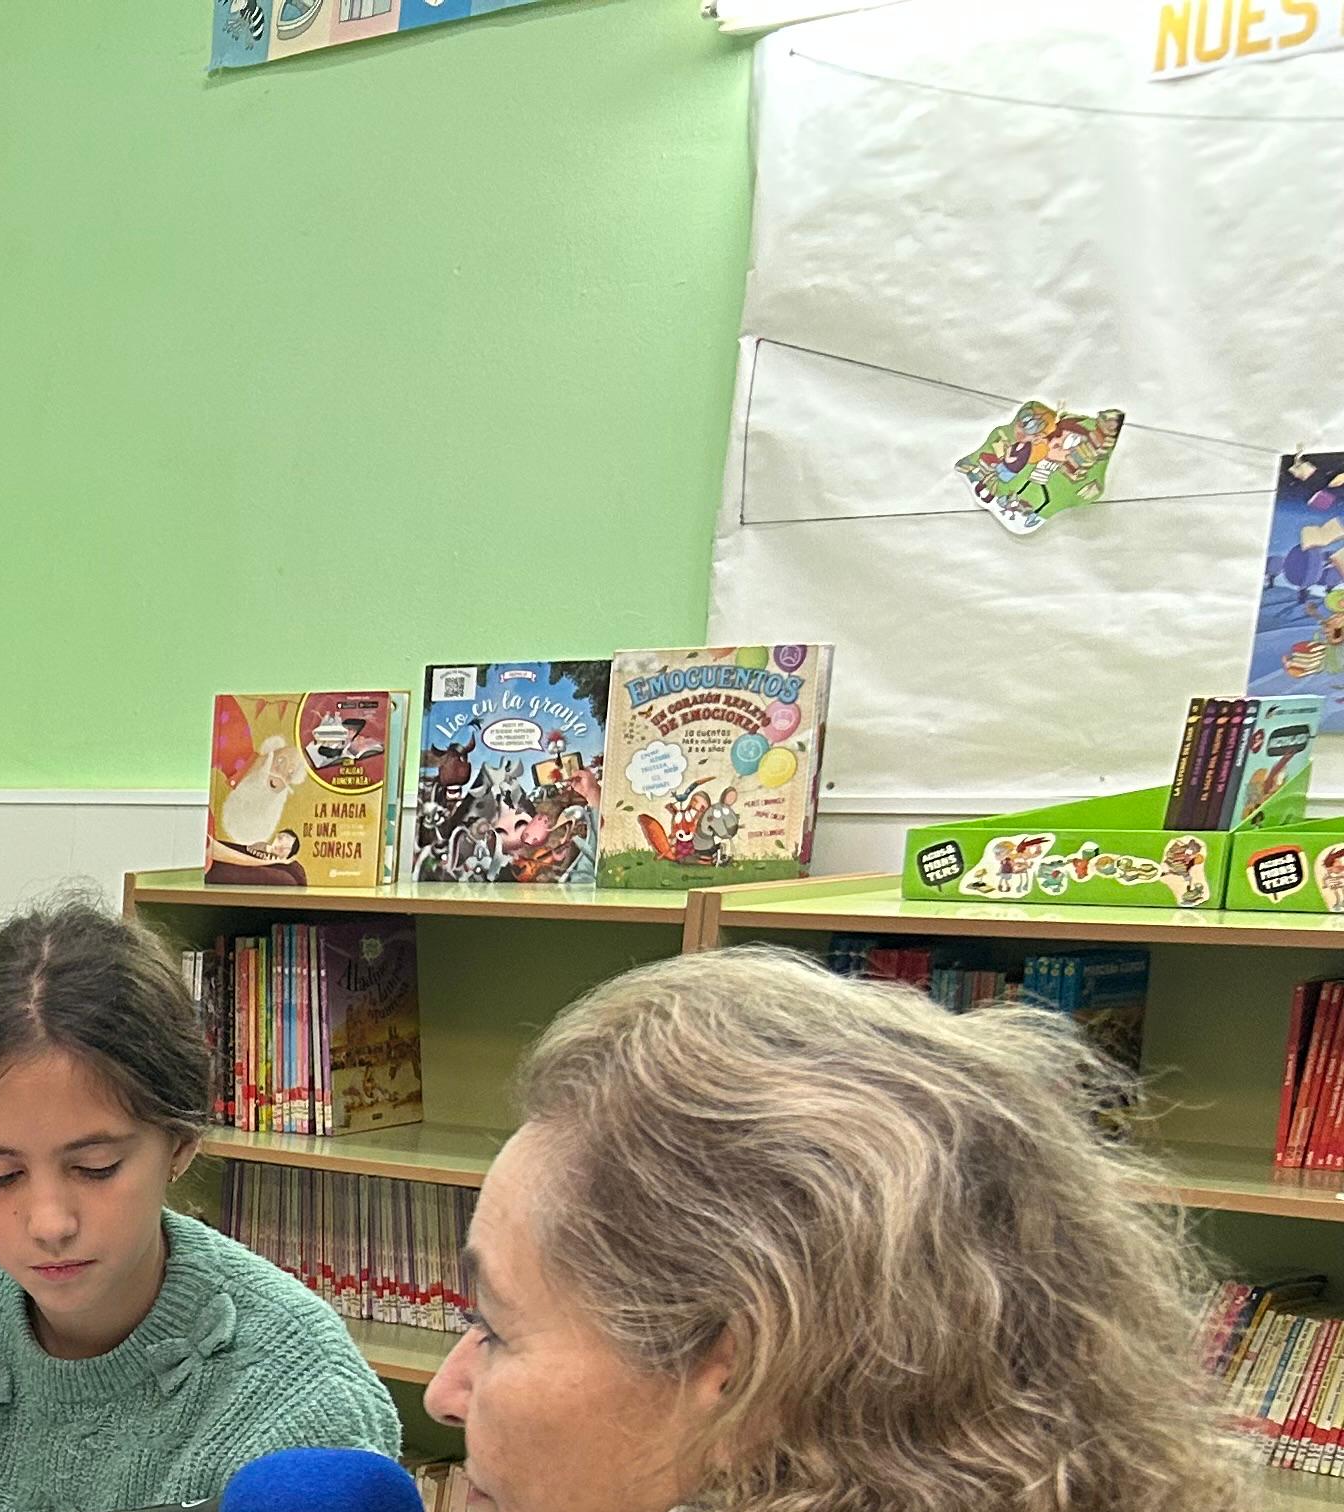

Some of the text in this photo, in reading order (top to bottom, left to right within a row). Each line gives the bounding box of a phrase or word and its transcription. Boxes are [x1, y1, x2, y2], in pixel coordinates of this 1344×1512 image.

[1153, 0, 1344, 73] NUES
[625, 665, 805, 709] EMOCUENTOS
[471, 698, 498, 717] en
[502, 690, 528, 710] la
[529, 694, 590, 738] granja
[681, 708, 761, 735] EMOCIONES
[314, 803, 367, 819] LA MAGIA
[313, 840, 363, 859] SONRISA
